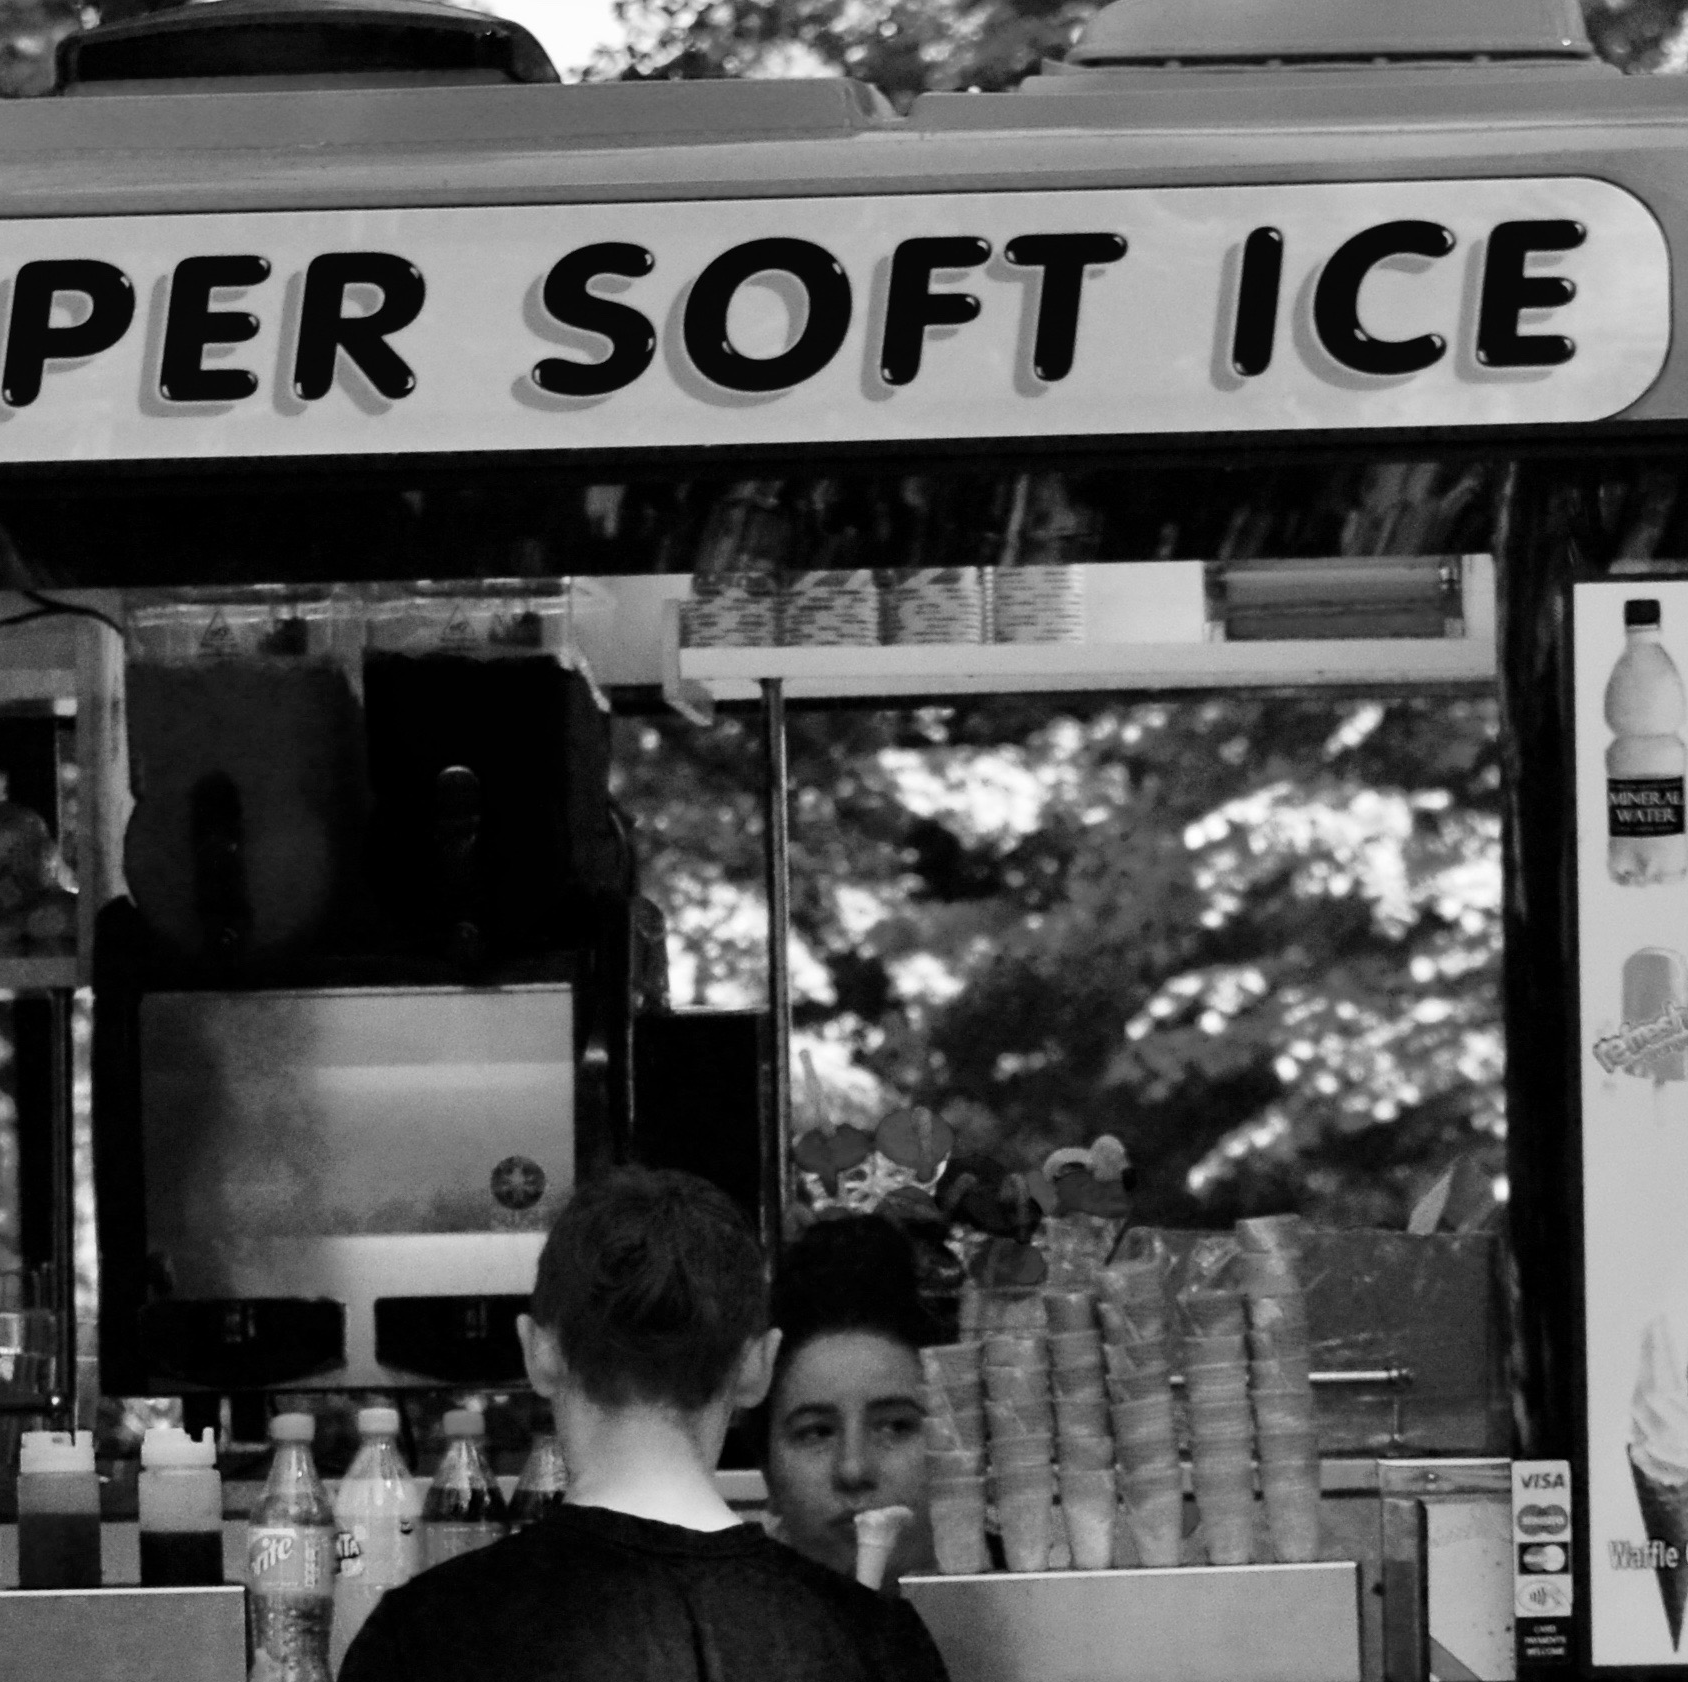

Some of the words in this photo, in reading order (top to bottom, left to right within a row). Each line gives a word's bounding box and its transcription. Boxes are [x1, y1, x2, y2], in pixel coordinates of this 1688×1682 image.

[519, 231, 1128, 402] SOFT
[1213, 218, 1588, 388] ICE
[1609, 791, 1681, 806] MINERAL
[1615, 808, 1677, 823] WATER
[1520, 1471, 1565, 1489] VISA
[1609, 1538, 1680, 1570] Waffle
